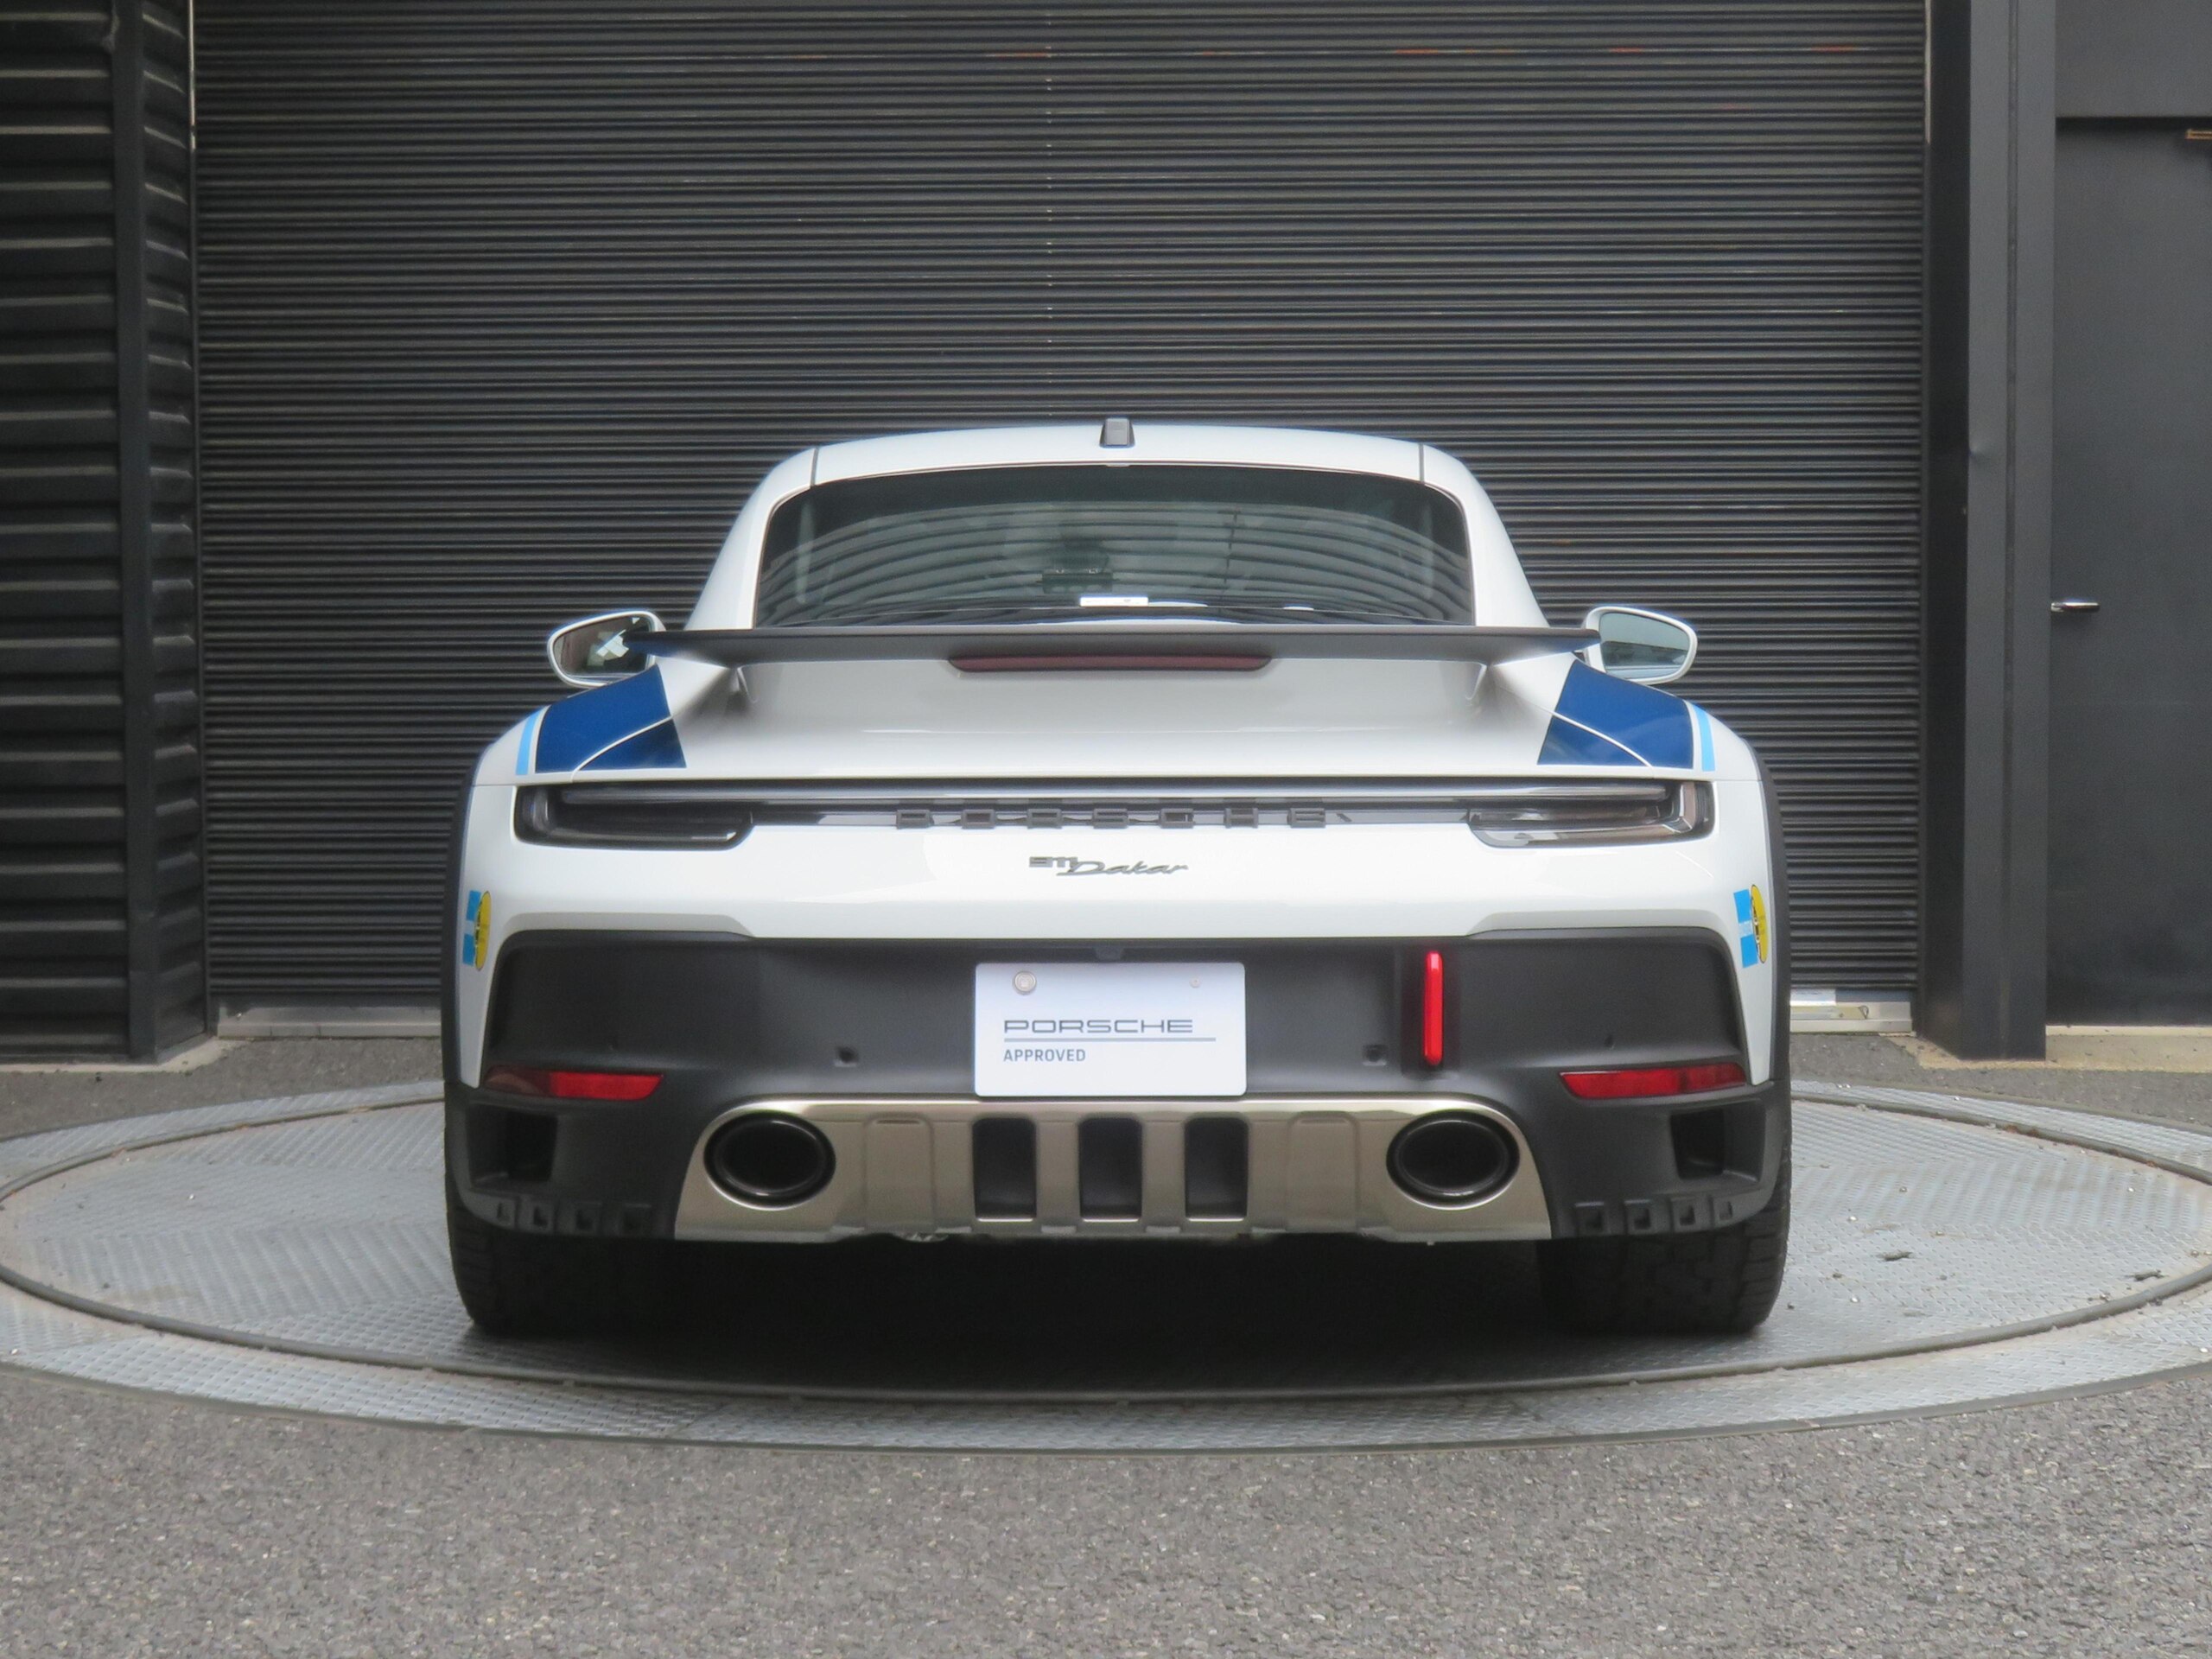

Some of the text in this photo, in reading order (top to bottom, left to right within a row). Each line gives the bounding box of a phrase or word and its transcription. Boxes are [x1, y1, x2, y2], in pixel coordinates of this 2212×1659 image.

[896, 808, 1325, 830] PORSCHE
[1056, 861, 1189, 876] Dakar
[1004, 1020, 1193, 1033] PORSCHE
[1003, 1049, 1086, 1062] APPROVED
